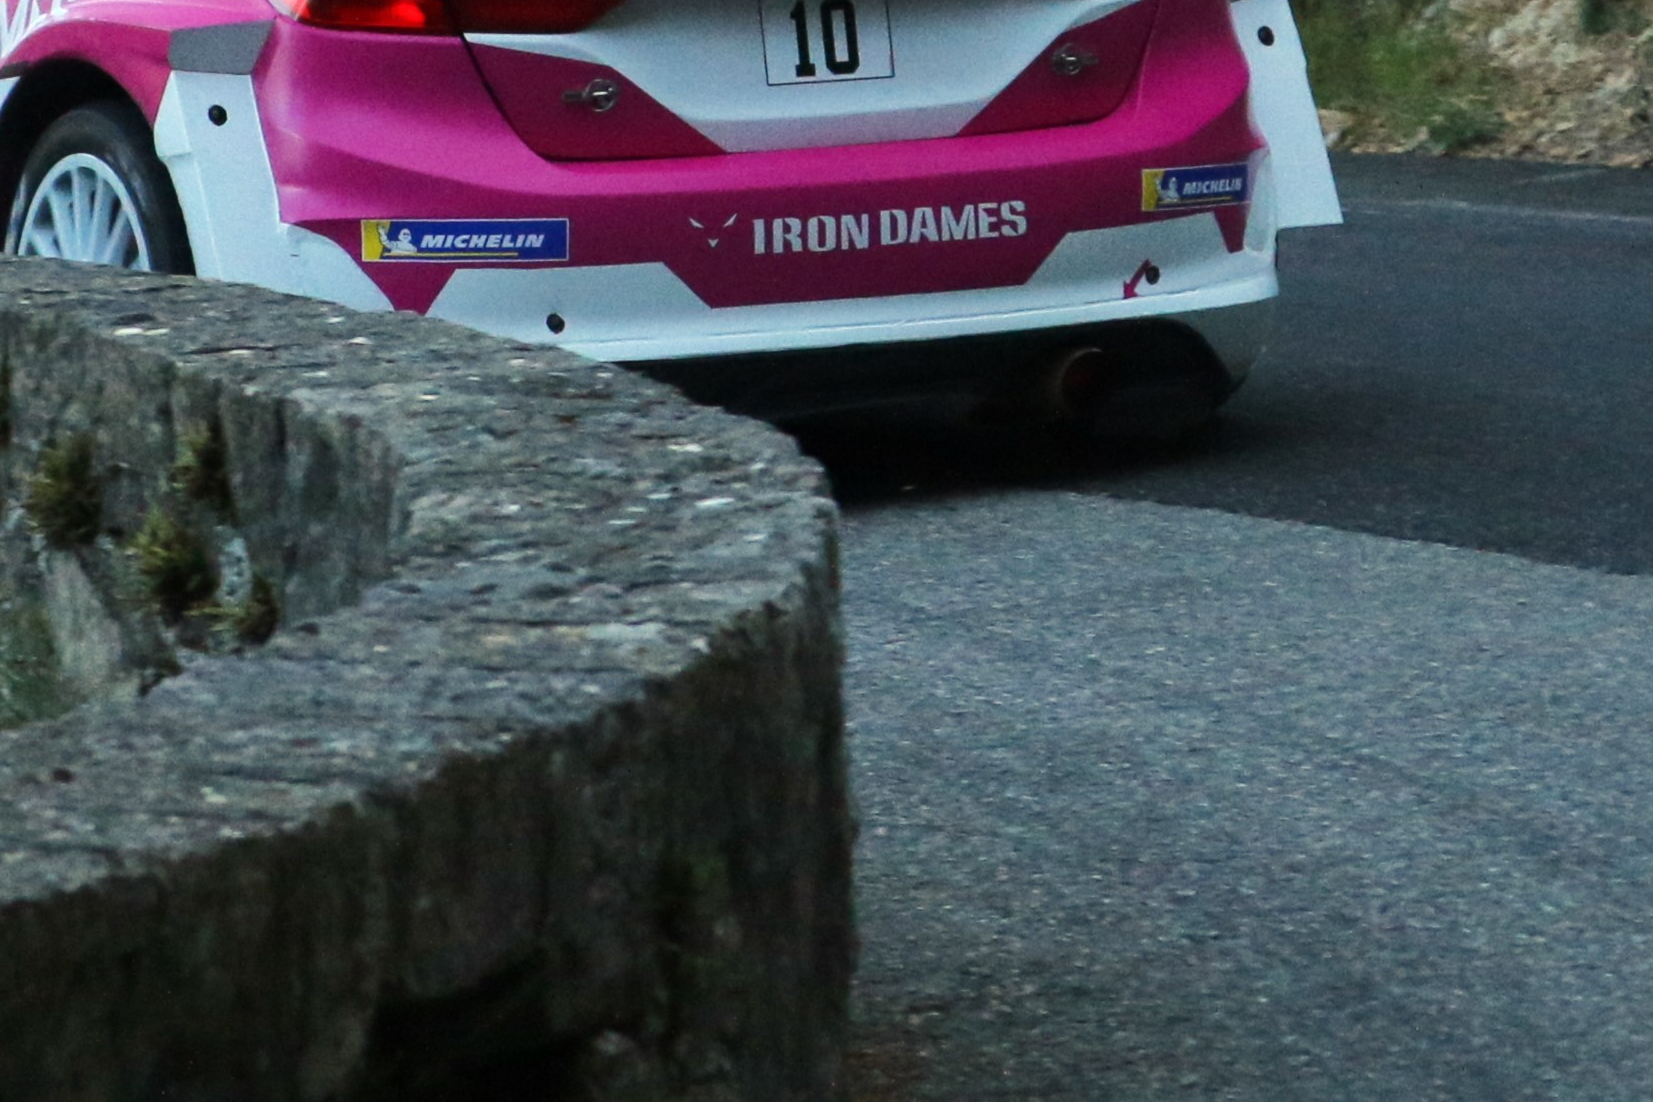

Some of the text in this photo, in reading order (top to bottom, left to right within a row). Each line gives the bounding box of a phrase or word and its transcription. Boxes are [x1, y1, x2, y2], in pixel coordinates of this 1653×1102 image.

[1182, 178, 1242, 195] MICHELIN
[753, 200, 1028, 255] IRON DAMES
[420, 234, 545, 248] MICHELIN
